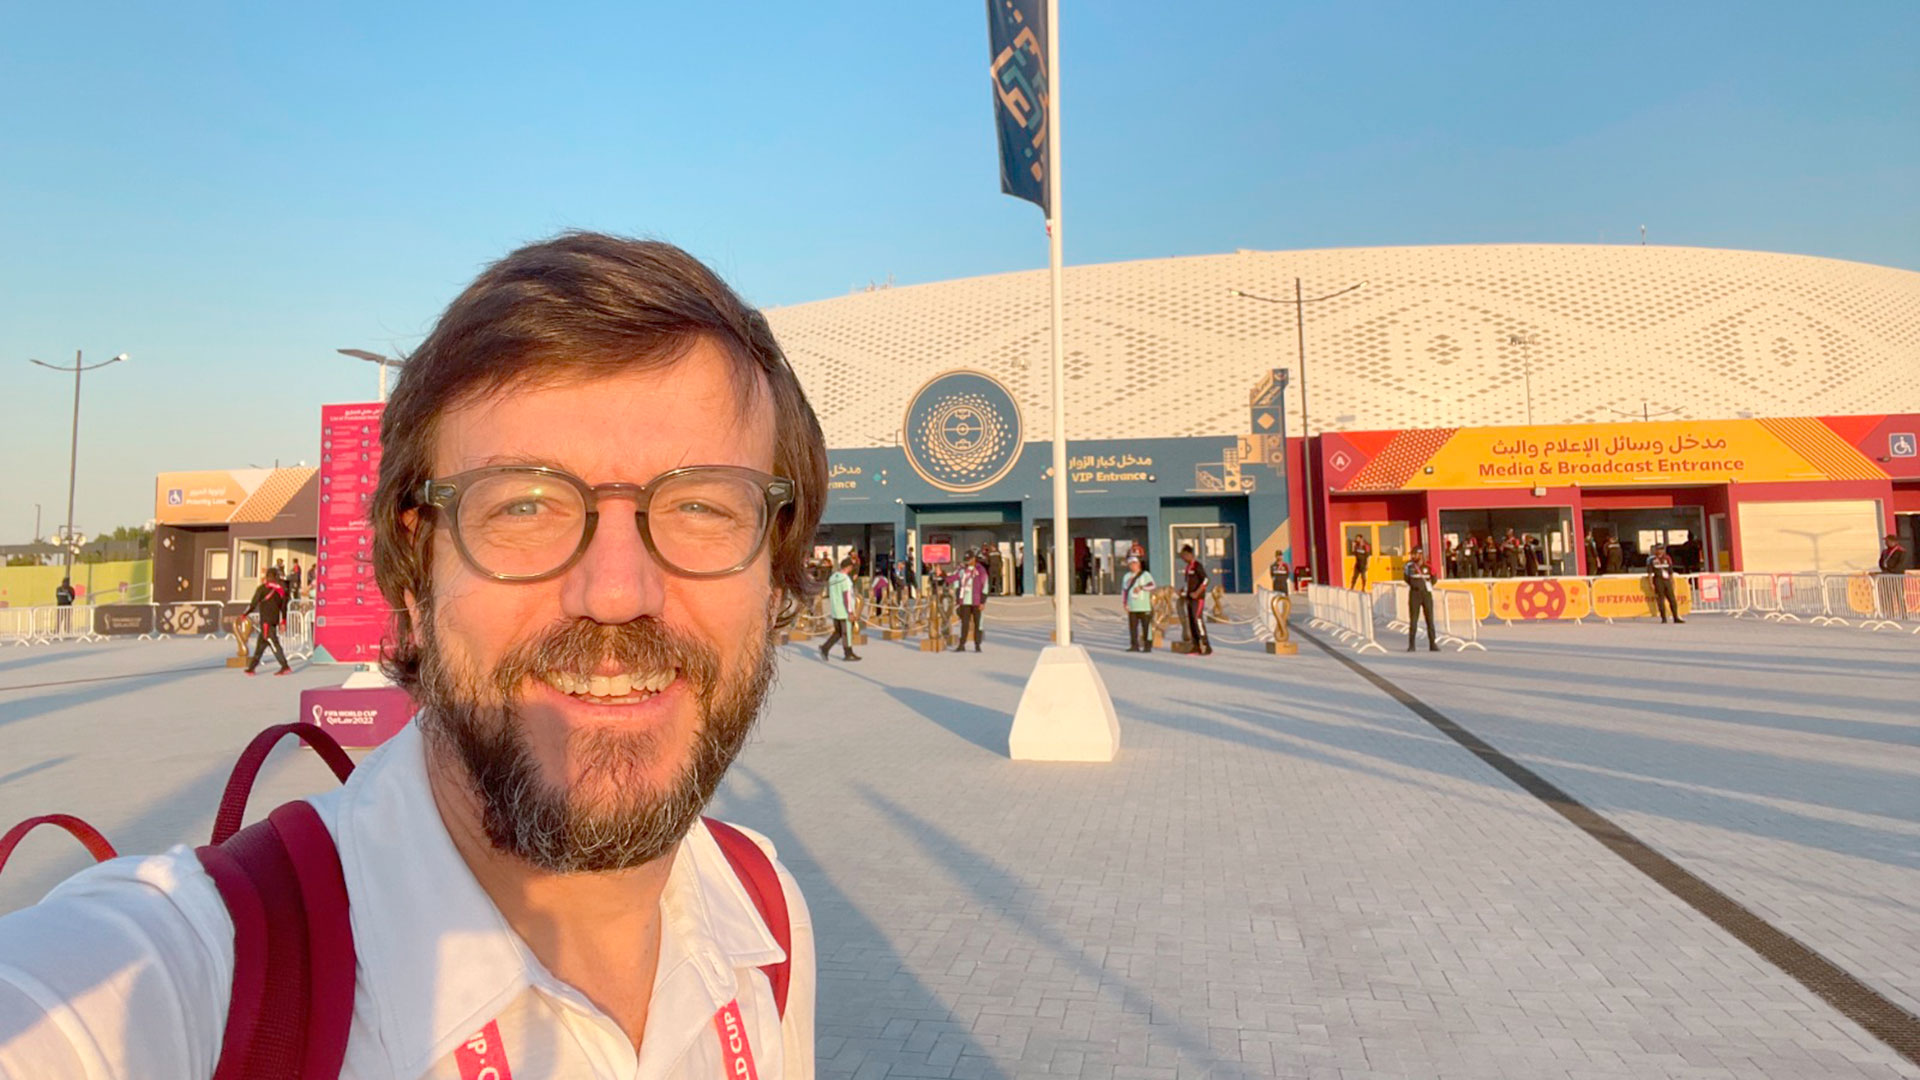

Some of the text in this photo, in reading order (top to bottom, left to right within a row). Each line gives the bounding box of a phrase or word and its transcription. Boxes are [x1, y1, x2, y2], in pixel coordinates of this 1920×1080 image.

[1492, 433, 1727, 459] مدخل وسائل الإعلام والبث
[1096, 456, 1115, 468] كبار
[1116, 454, 1152, 468] مدخل
[1479, 457, 1745, 477] Media & Broadcast Entrance
[1072, 472, 1147, 482] VIP Entrance
[723, 1011, 743, 1055] CUP
